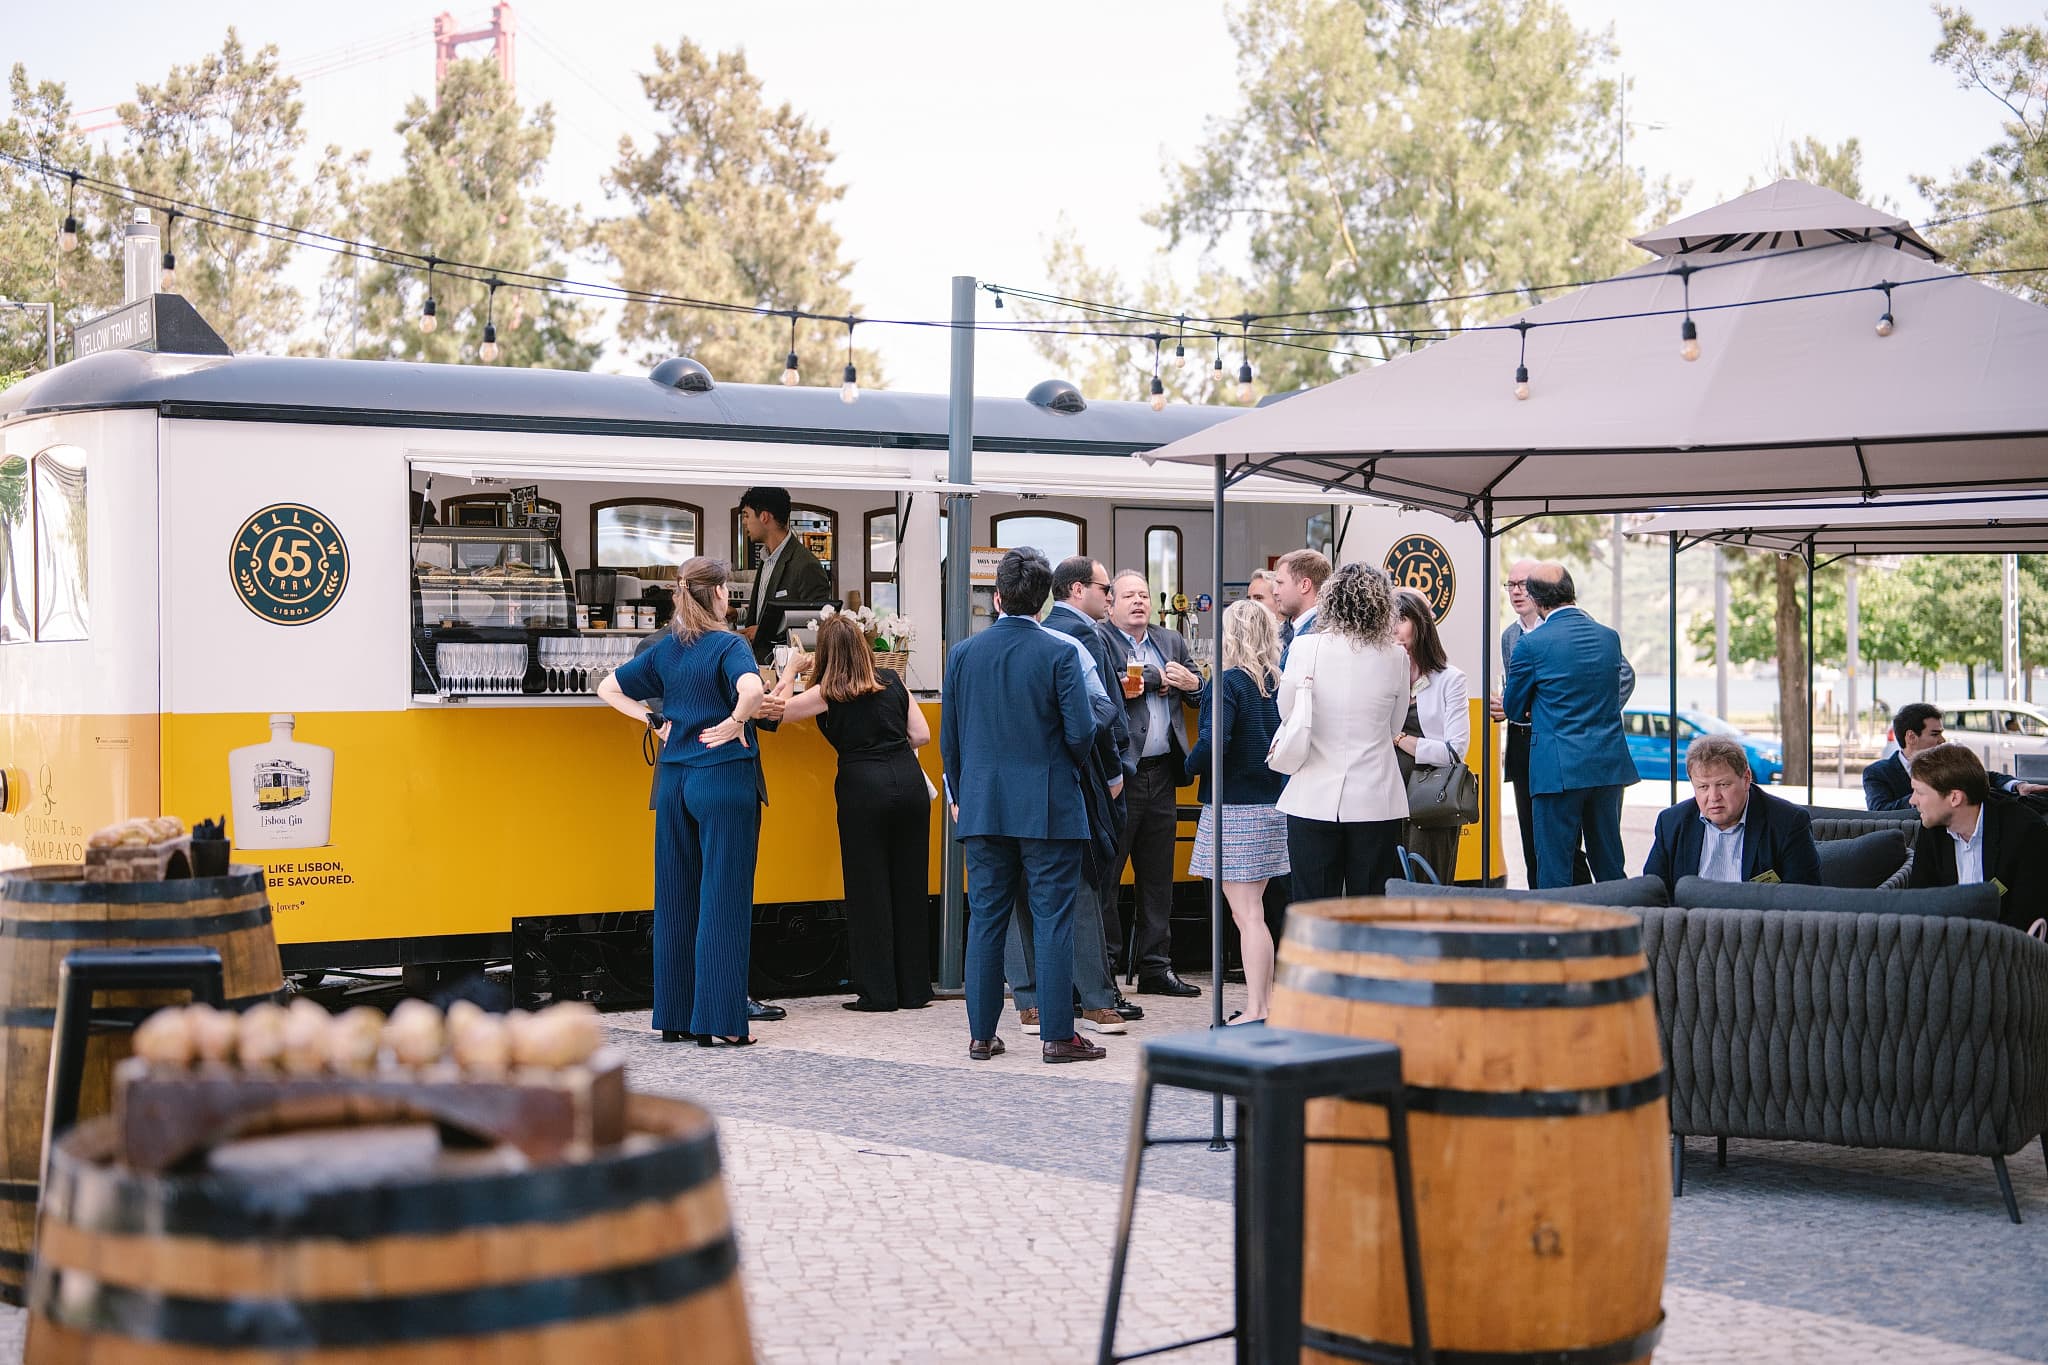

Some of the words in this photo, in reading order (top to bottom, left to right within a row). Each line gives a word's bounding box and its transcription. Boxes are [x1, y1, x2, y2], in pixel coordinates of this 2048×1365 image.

[80, 328, 110, 356] YELLOW
[110, 317, 132, 345] TRAM
[139, 311, 149, 335] 65
[238, 511, 340, 555] YELLOW
[268, 536, 312, 577] 65
[1386, 540, 1450, 575] YELLOW
[1405, 559, 1432, 592] 65
[273, 607, 309, 616] LISBOA
[24, 815, 66, 836] QUINTA
[24, 836, 83, 861] SAMPAYO
[268, 863, 294, 874] LIKE
[297, 861, 344, 873] LISBON,
[268, 878, 284, 888] BE
[287, 875, 355, 887] SAVOURED.
